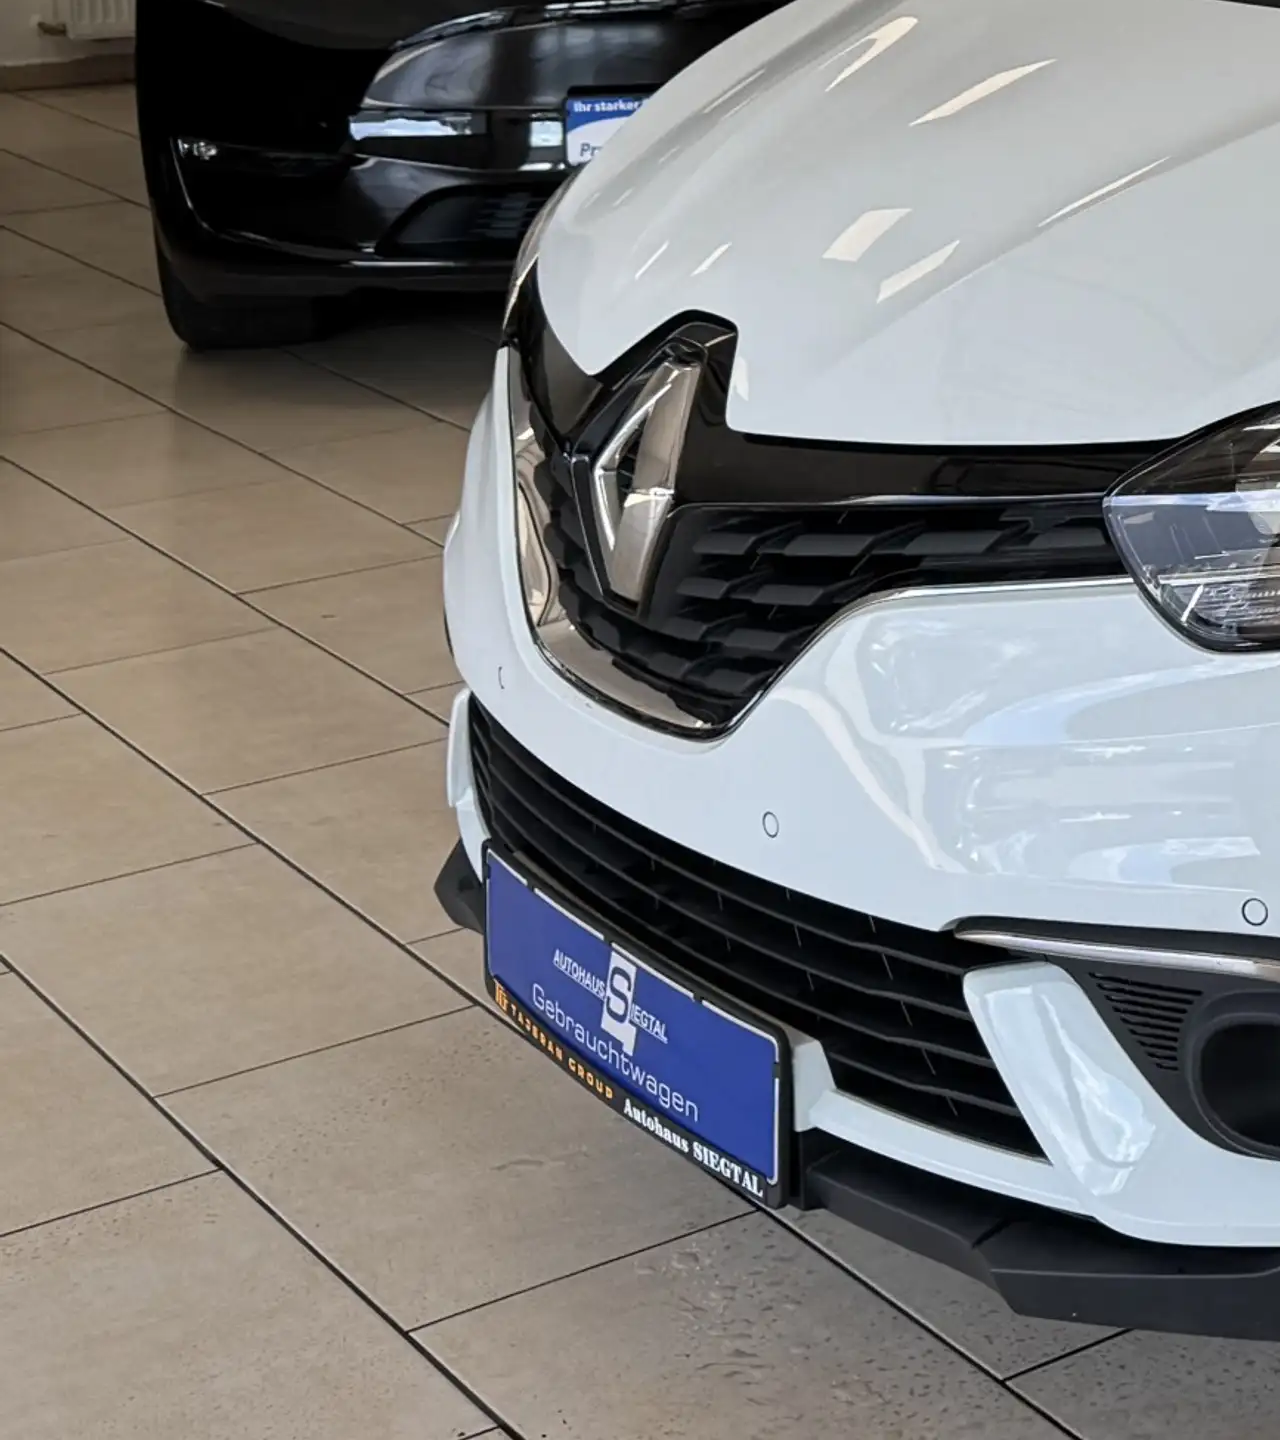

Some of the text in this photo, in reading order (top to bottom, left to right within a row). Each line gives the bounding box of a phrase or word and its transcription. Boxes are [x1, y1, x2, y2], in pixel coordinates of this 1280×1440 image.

[553, 949, 605, 1000] AUTOHAUS
[532, 983, 699, 1122] Gebrauchtwagen
[568, 1057, 613, 1099] GROUP
[623, 1099, 689, 1153] Autohaus
[692, 1142, 764, 1198] SIEGTAL
